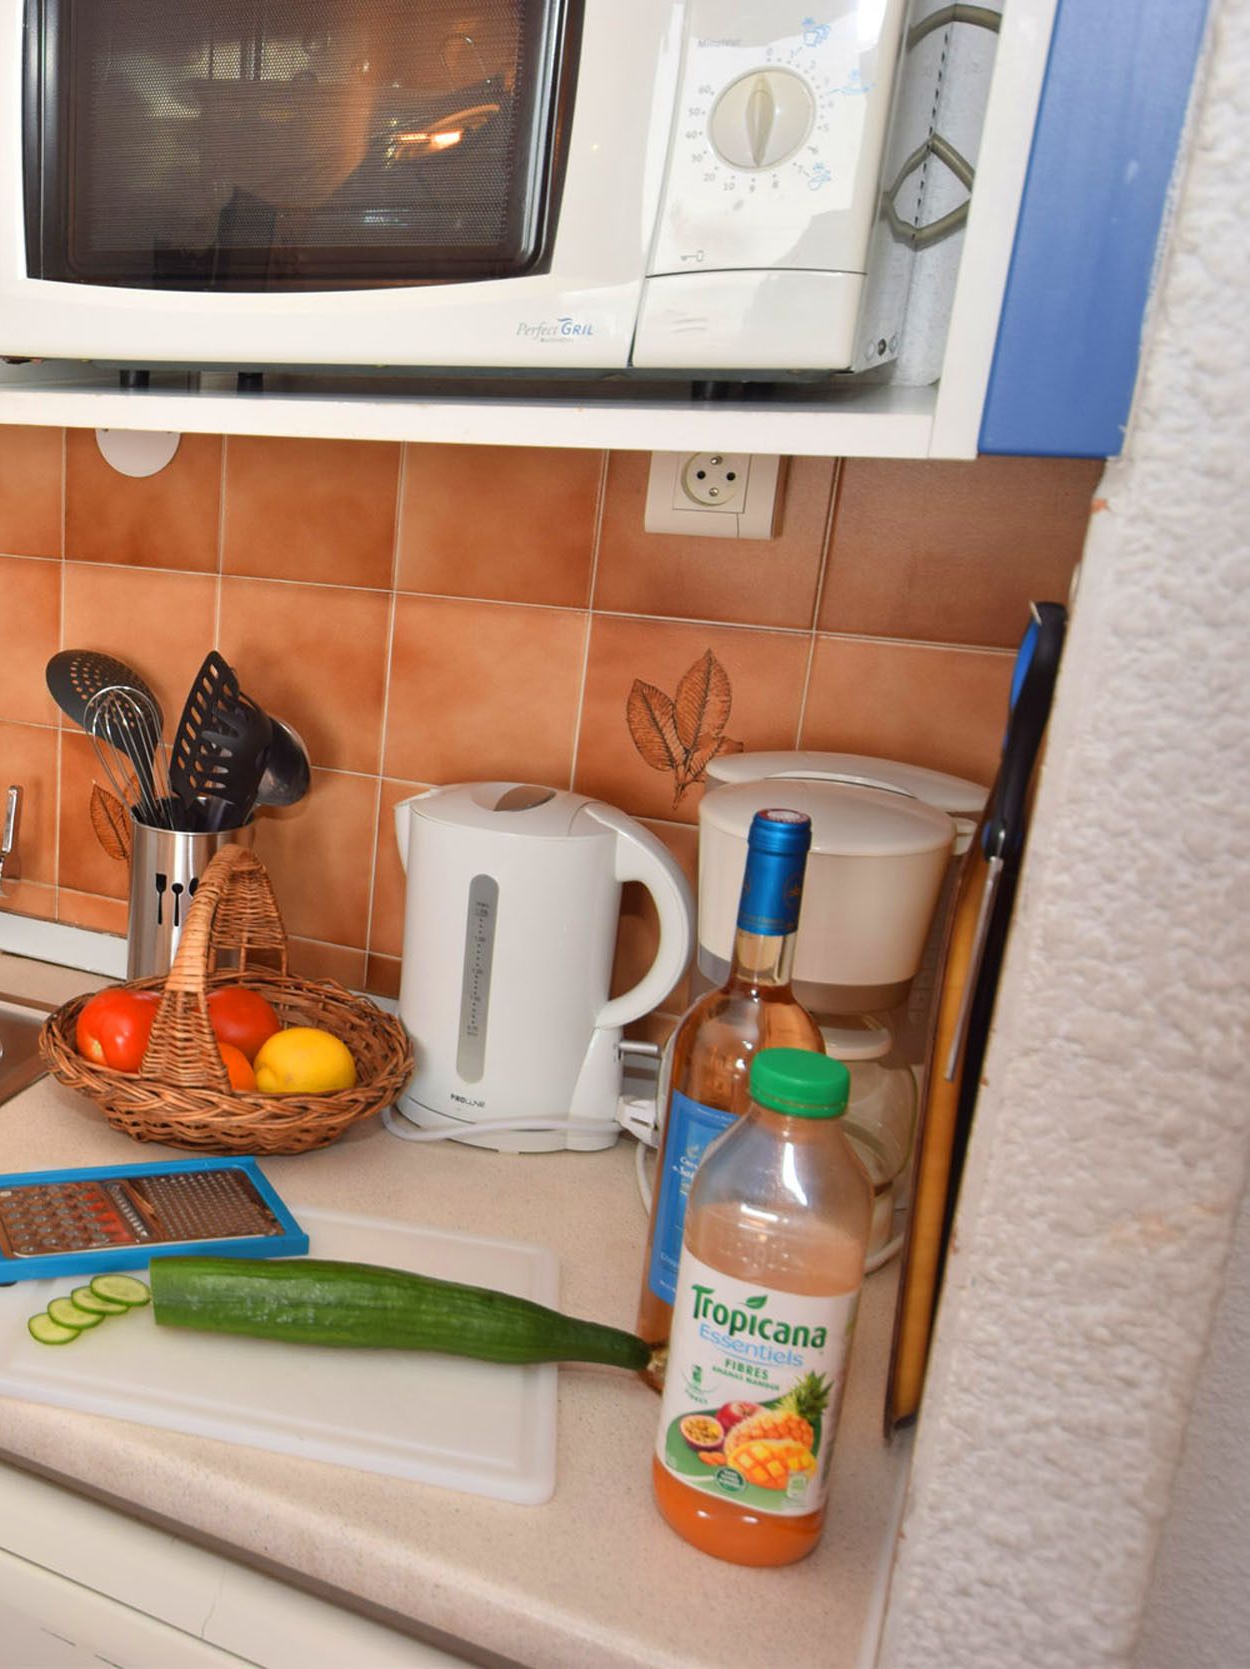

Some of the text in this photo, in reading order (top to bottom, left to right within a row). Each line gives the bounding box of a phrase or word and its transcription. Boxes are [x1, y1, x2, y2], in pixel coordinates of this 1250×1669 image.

[516, 321, 559, 340] Perfect
[691, 1284, 827, 1348] Tropicana
[699, 1323, 805, 1368] Essentiels
[725, 1358, 769, 1380] FIBRES
